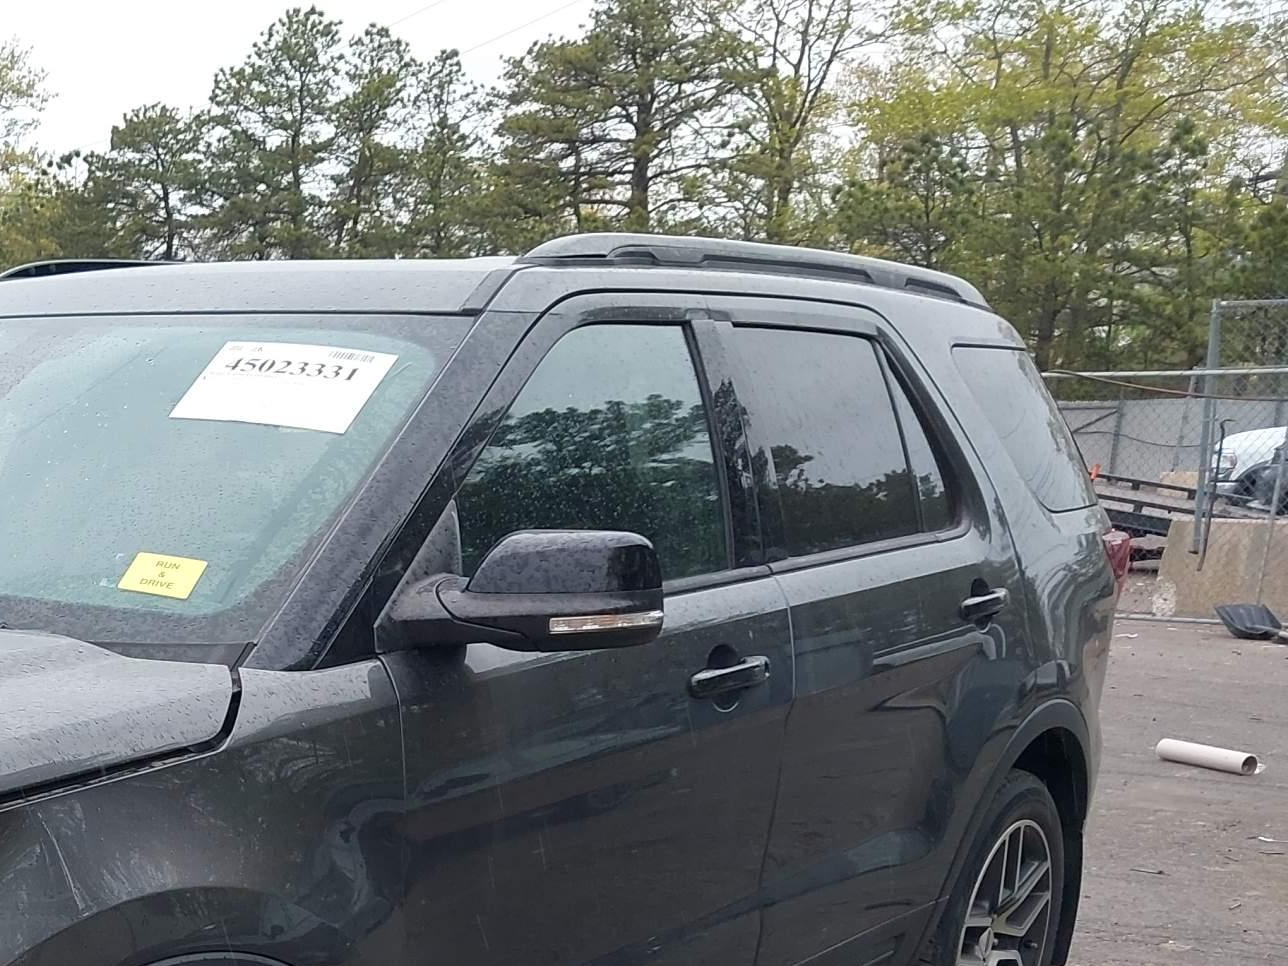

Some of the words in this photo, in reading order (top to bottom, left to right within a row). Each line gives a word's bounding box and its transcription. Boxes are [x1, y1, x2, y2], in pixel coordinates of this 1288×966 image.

[224, 358, 360, 381] 45023331
[155, 560, 181, 570] RUN
[139, 577, 176, 590] DRIVE
